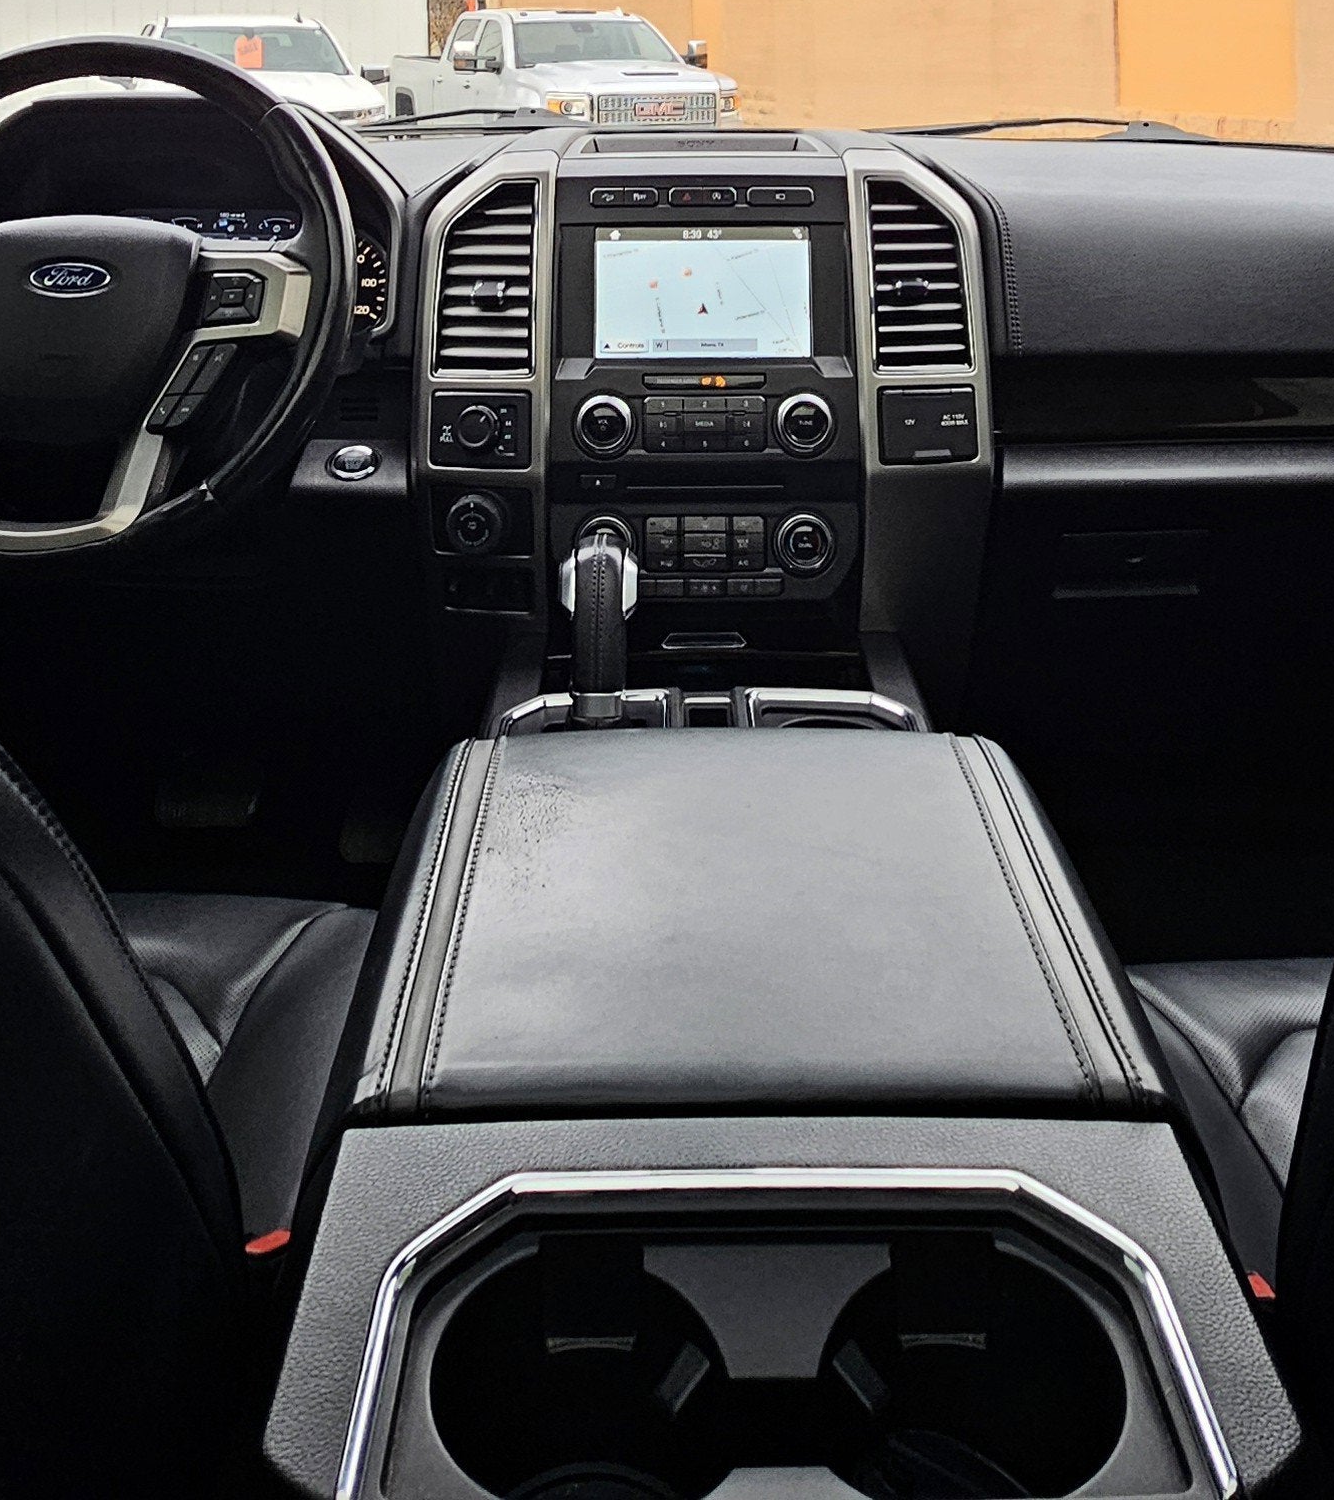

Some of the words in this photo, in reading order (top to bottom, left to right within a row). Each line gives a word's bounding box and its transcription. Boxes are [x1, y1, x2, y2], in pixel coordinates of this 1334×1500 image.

[636, 102, 685, 116] GMC
[43, 267, 95, 286] Ford
[361, 278, 377, 287] 100
[353, 305, 370, 315] 120
